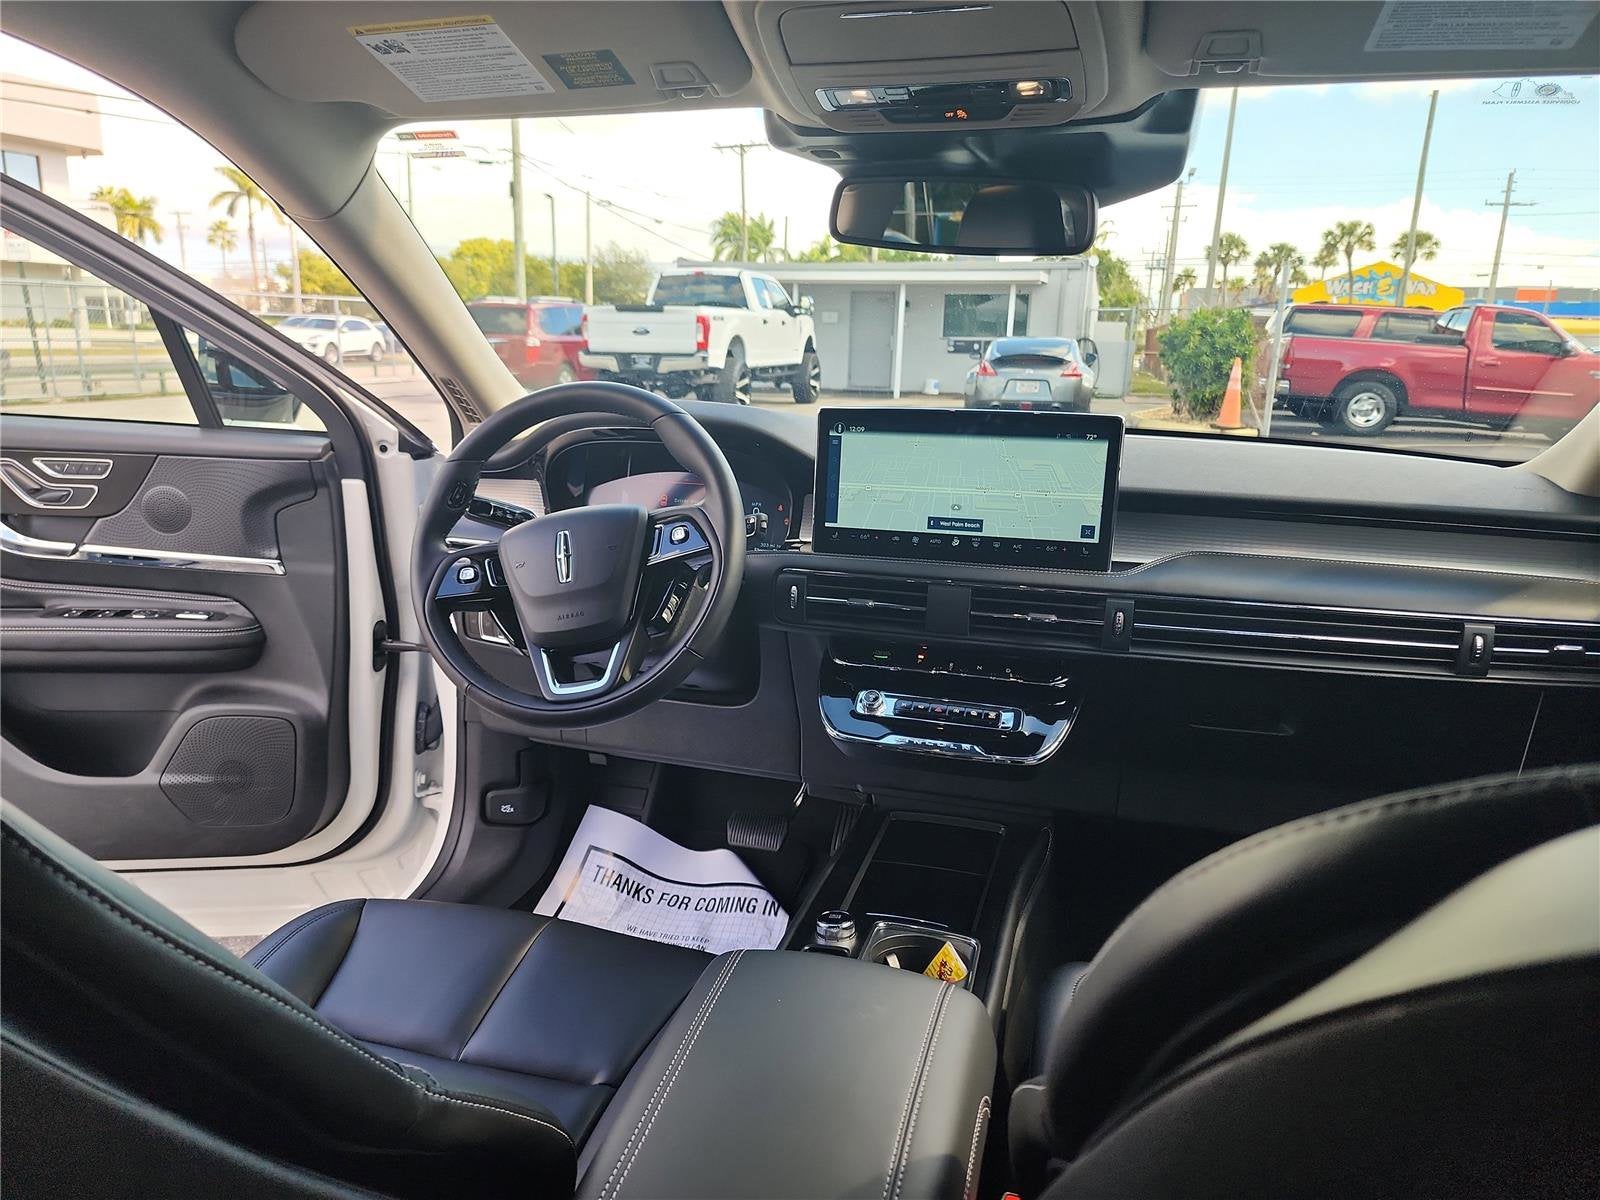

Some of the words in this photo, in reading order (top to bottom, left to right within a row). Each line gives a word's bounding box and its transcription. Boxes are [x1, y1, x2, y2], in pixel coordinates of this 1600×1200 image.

[592, 864, 655, 905] THANKS
[657, 892, 692, 911] FOR
[694, 895, 759, 914] COMING
[762, 898, 781, 917] IN
[626, 923, 638, 934] WE
[640, 928, 659, 938] HAVE
[659, 931, 680, 941] TRIED
